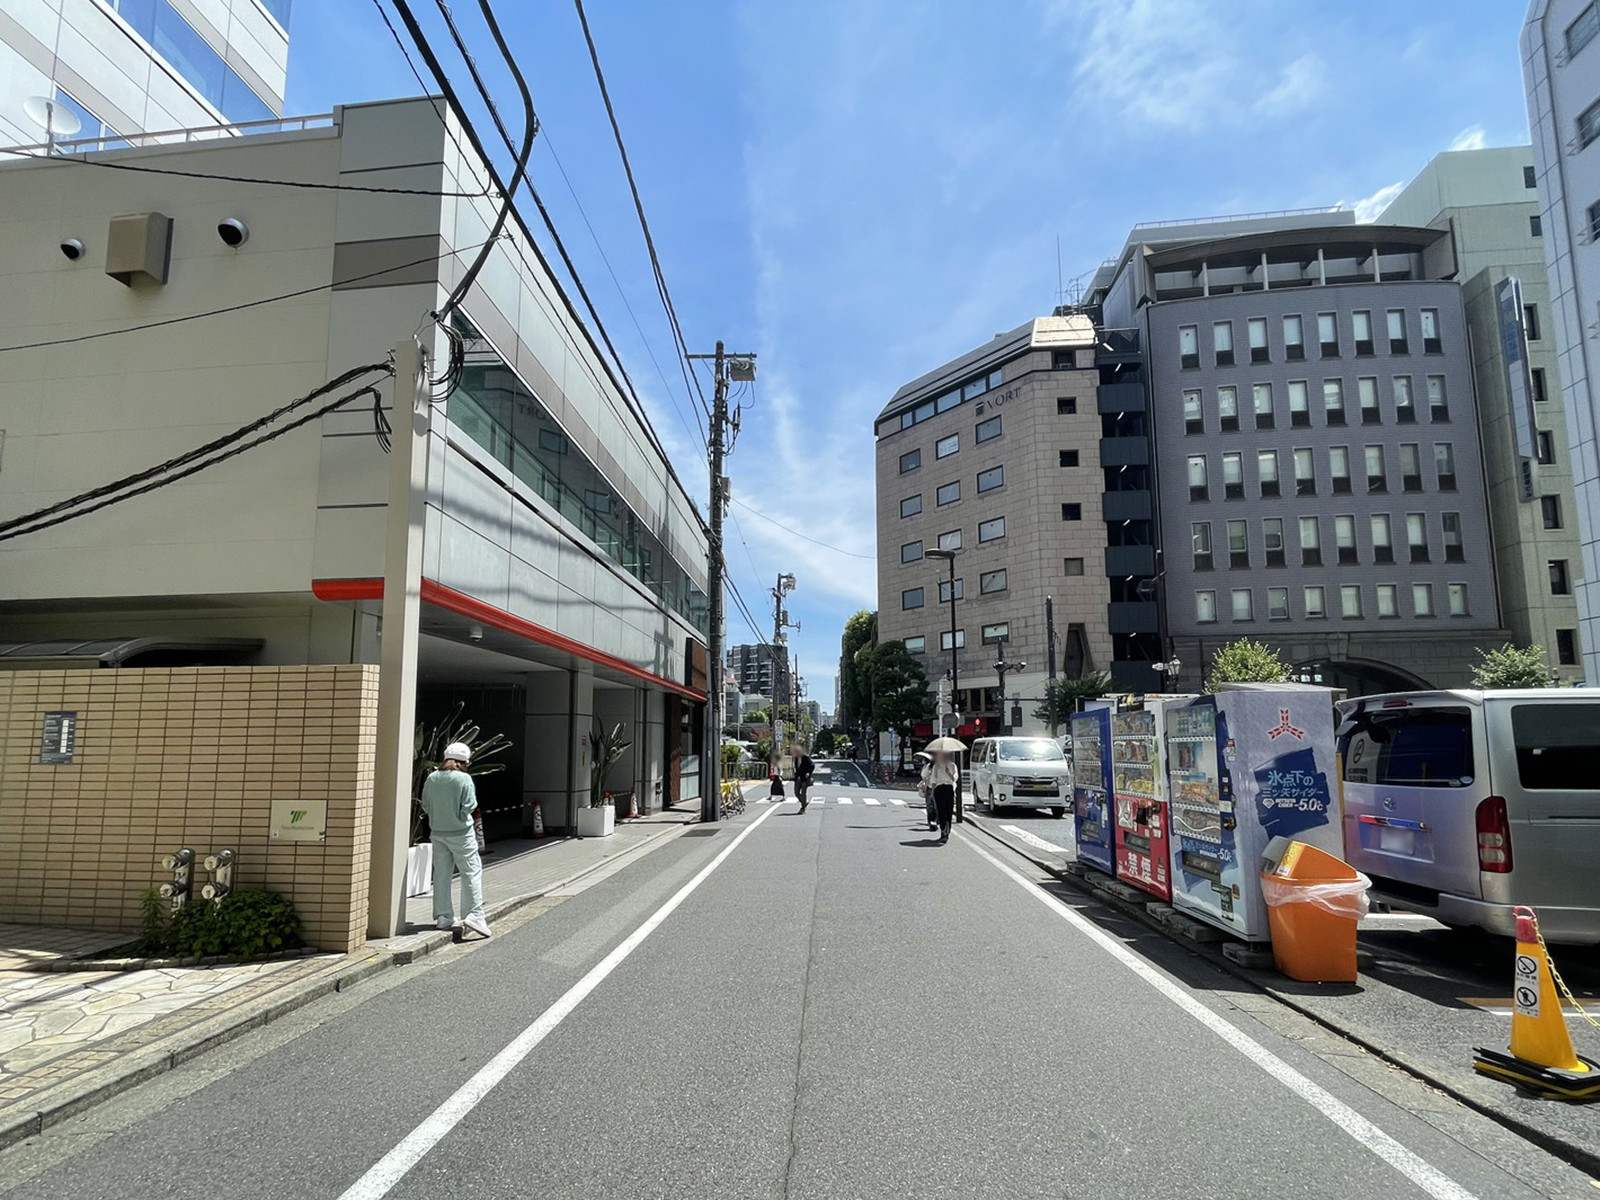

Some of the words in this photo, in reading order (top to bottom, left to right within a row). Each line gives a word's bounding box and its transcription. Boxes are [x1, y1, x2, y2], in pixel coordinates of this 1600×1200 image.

[1268, 770, 1314, 787] 氷点下の
[1261, 788, 1324, 798] 三ツ矢サイダー
